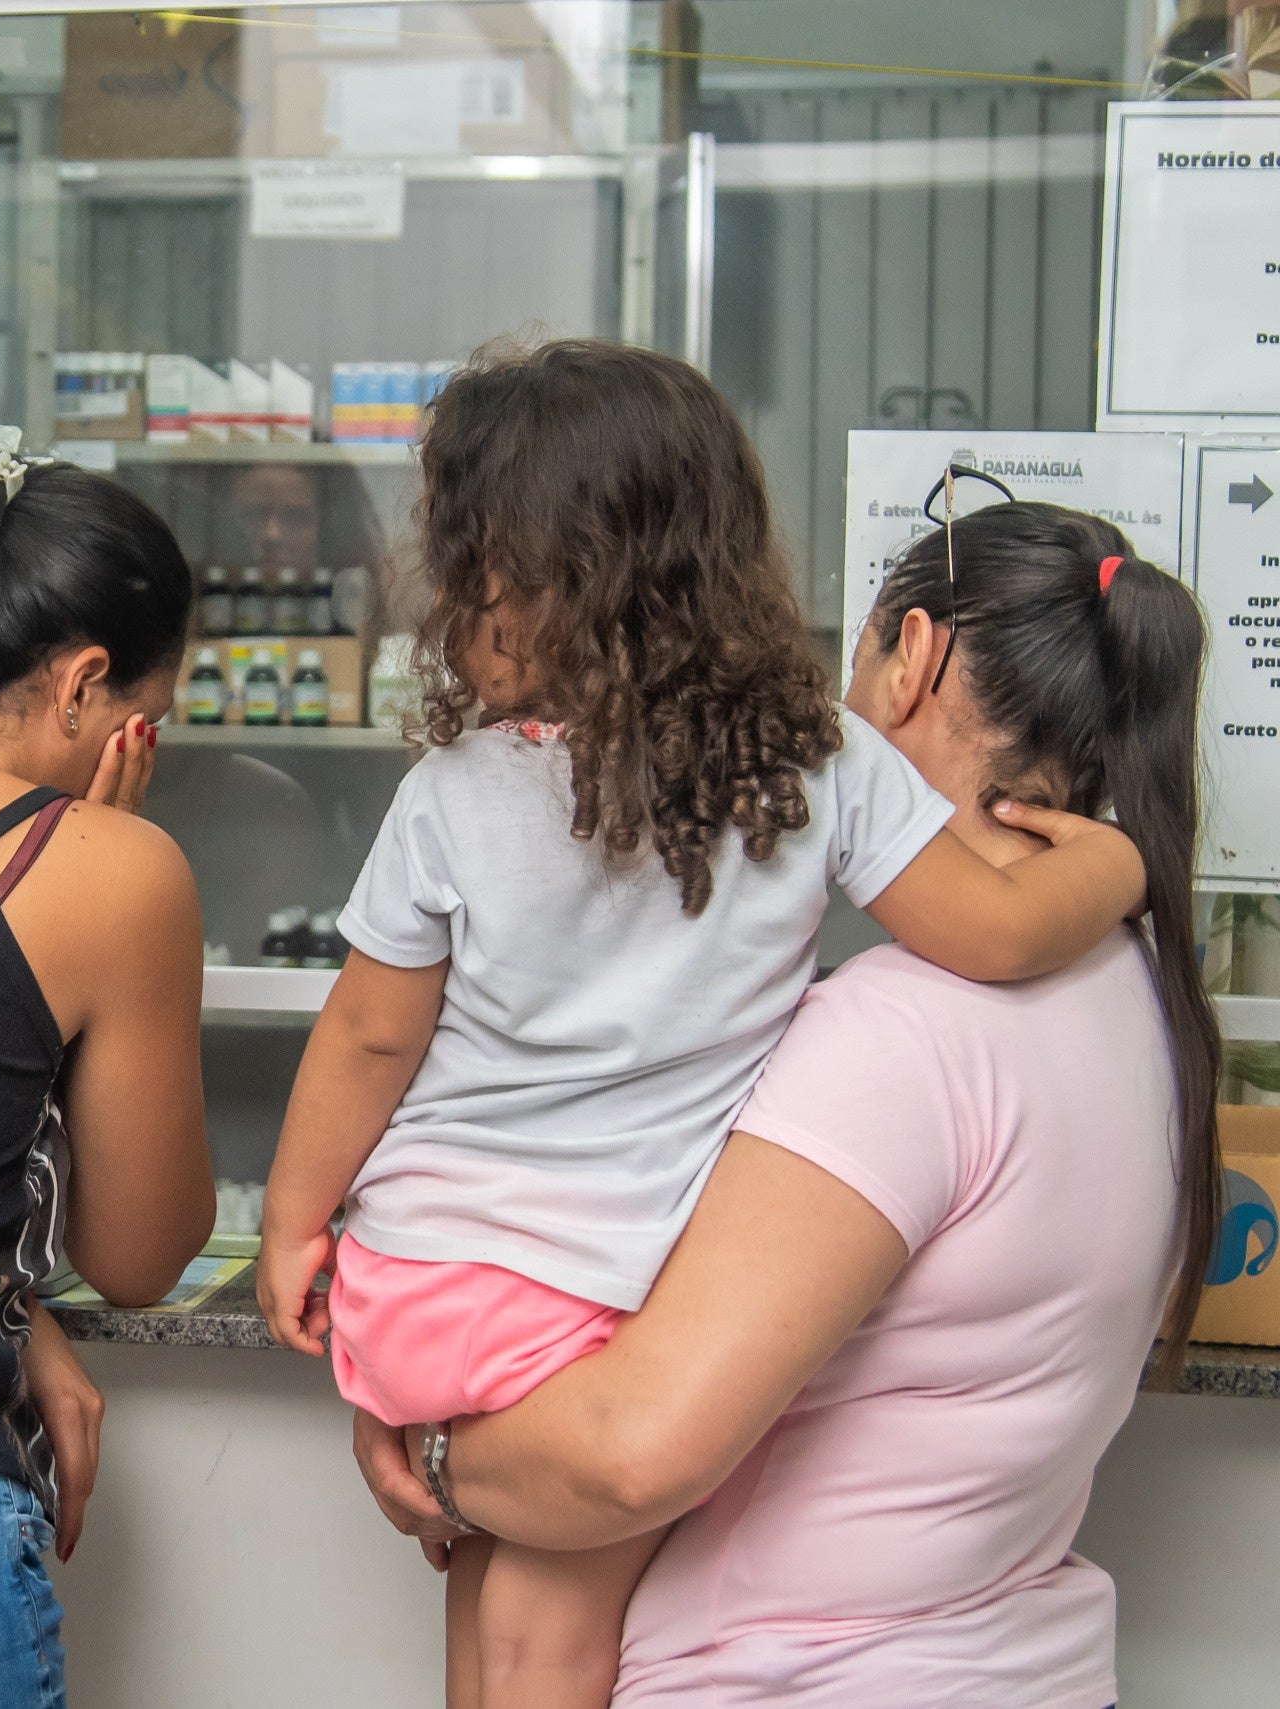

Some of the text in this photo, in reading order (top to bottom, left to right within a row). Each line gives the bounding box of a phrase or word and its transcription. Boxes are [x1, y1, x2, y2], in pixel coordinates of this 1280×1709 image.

[1157, 151, 1251, 168] Horário
[1265, 262, 1280, 274] D
[983, 458, 1083, 477] PARANAGUÁ
[868, 500, 879, 516] É
[1142, 509, 1162, 524] às
[1228, 614, 1280, 627] docu
[1245, 637, 1257, 647] o
[1223, 724, 1278, 737] Grato
